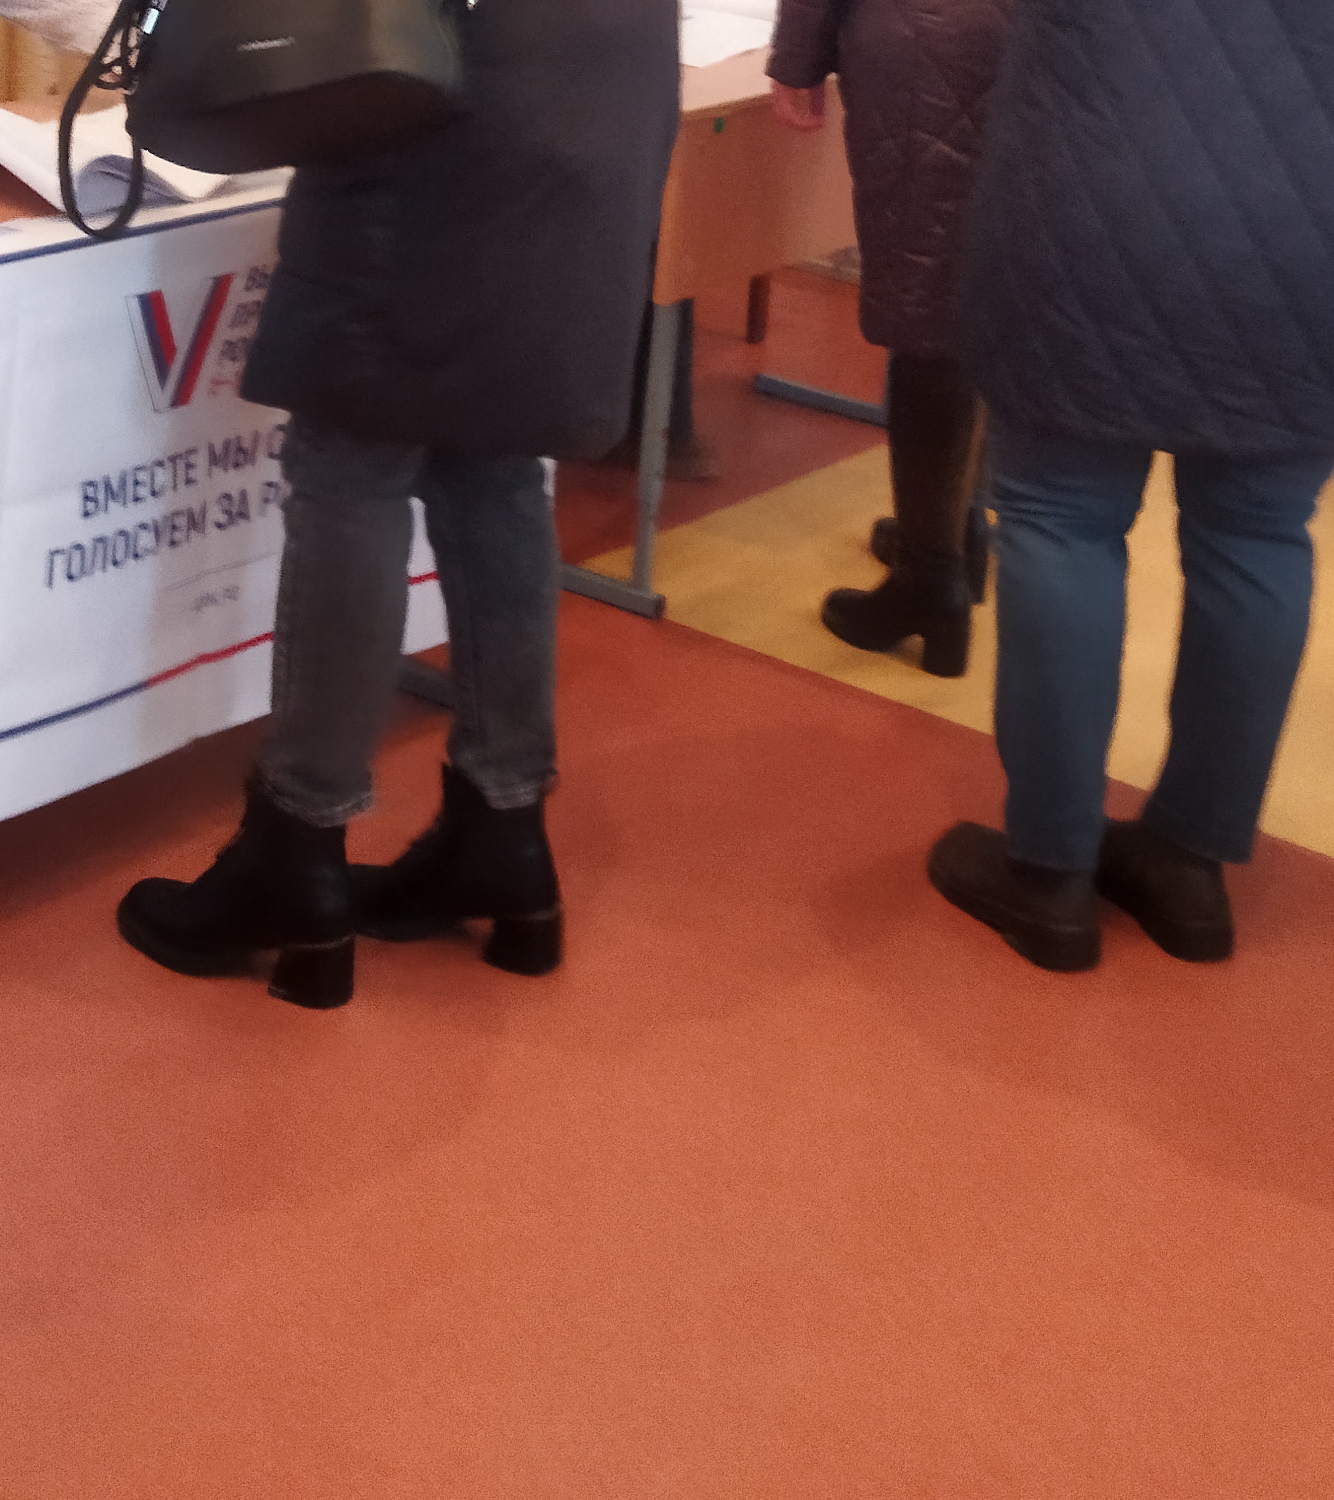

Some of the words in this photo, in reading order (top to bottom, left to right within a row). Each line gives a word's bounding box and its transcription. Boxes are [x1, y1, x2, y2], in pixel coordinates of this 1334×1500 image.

[78, 448, 199, 520] ВМЕСТЕ
[207, 430, 260, 479] МЫ
[44, 500, 208, 589] ГОЛОСУЕМ
[213, 489, 251, 531] ЗА
